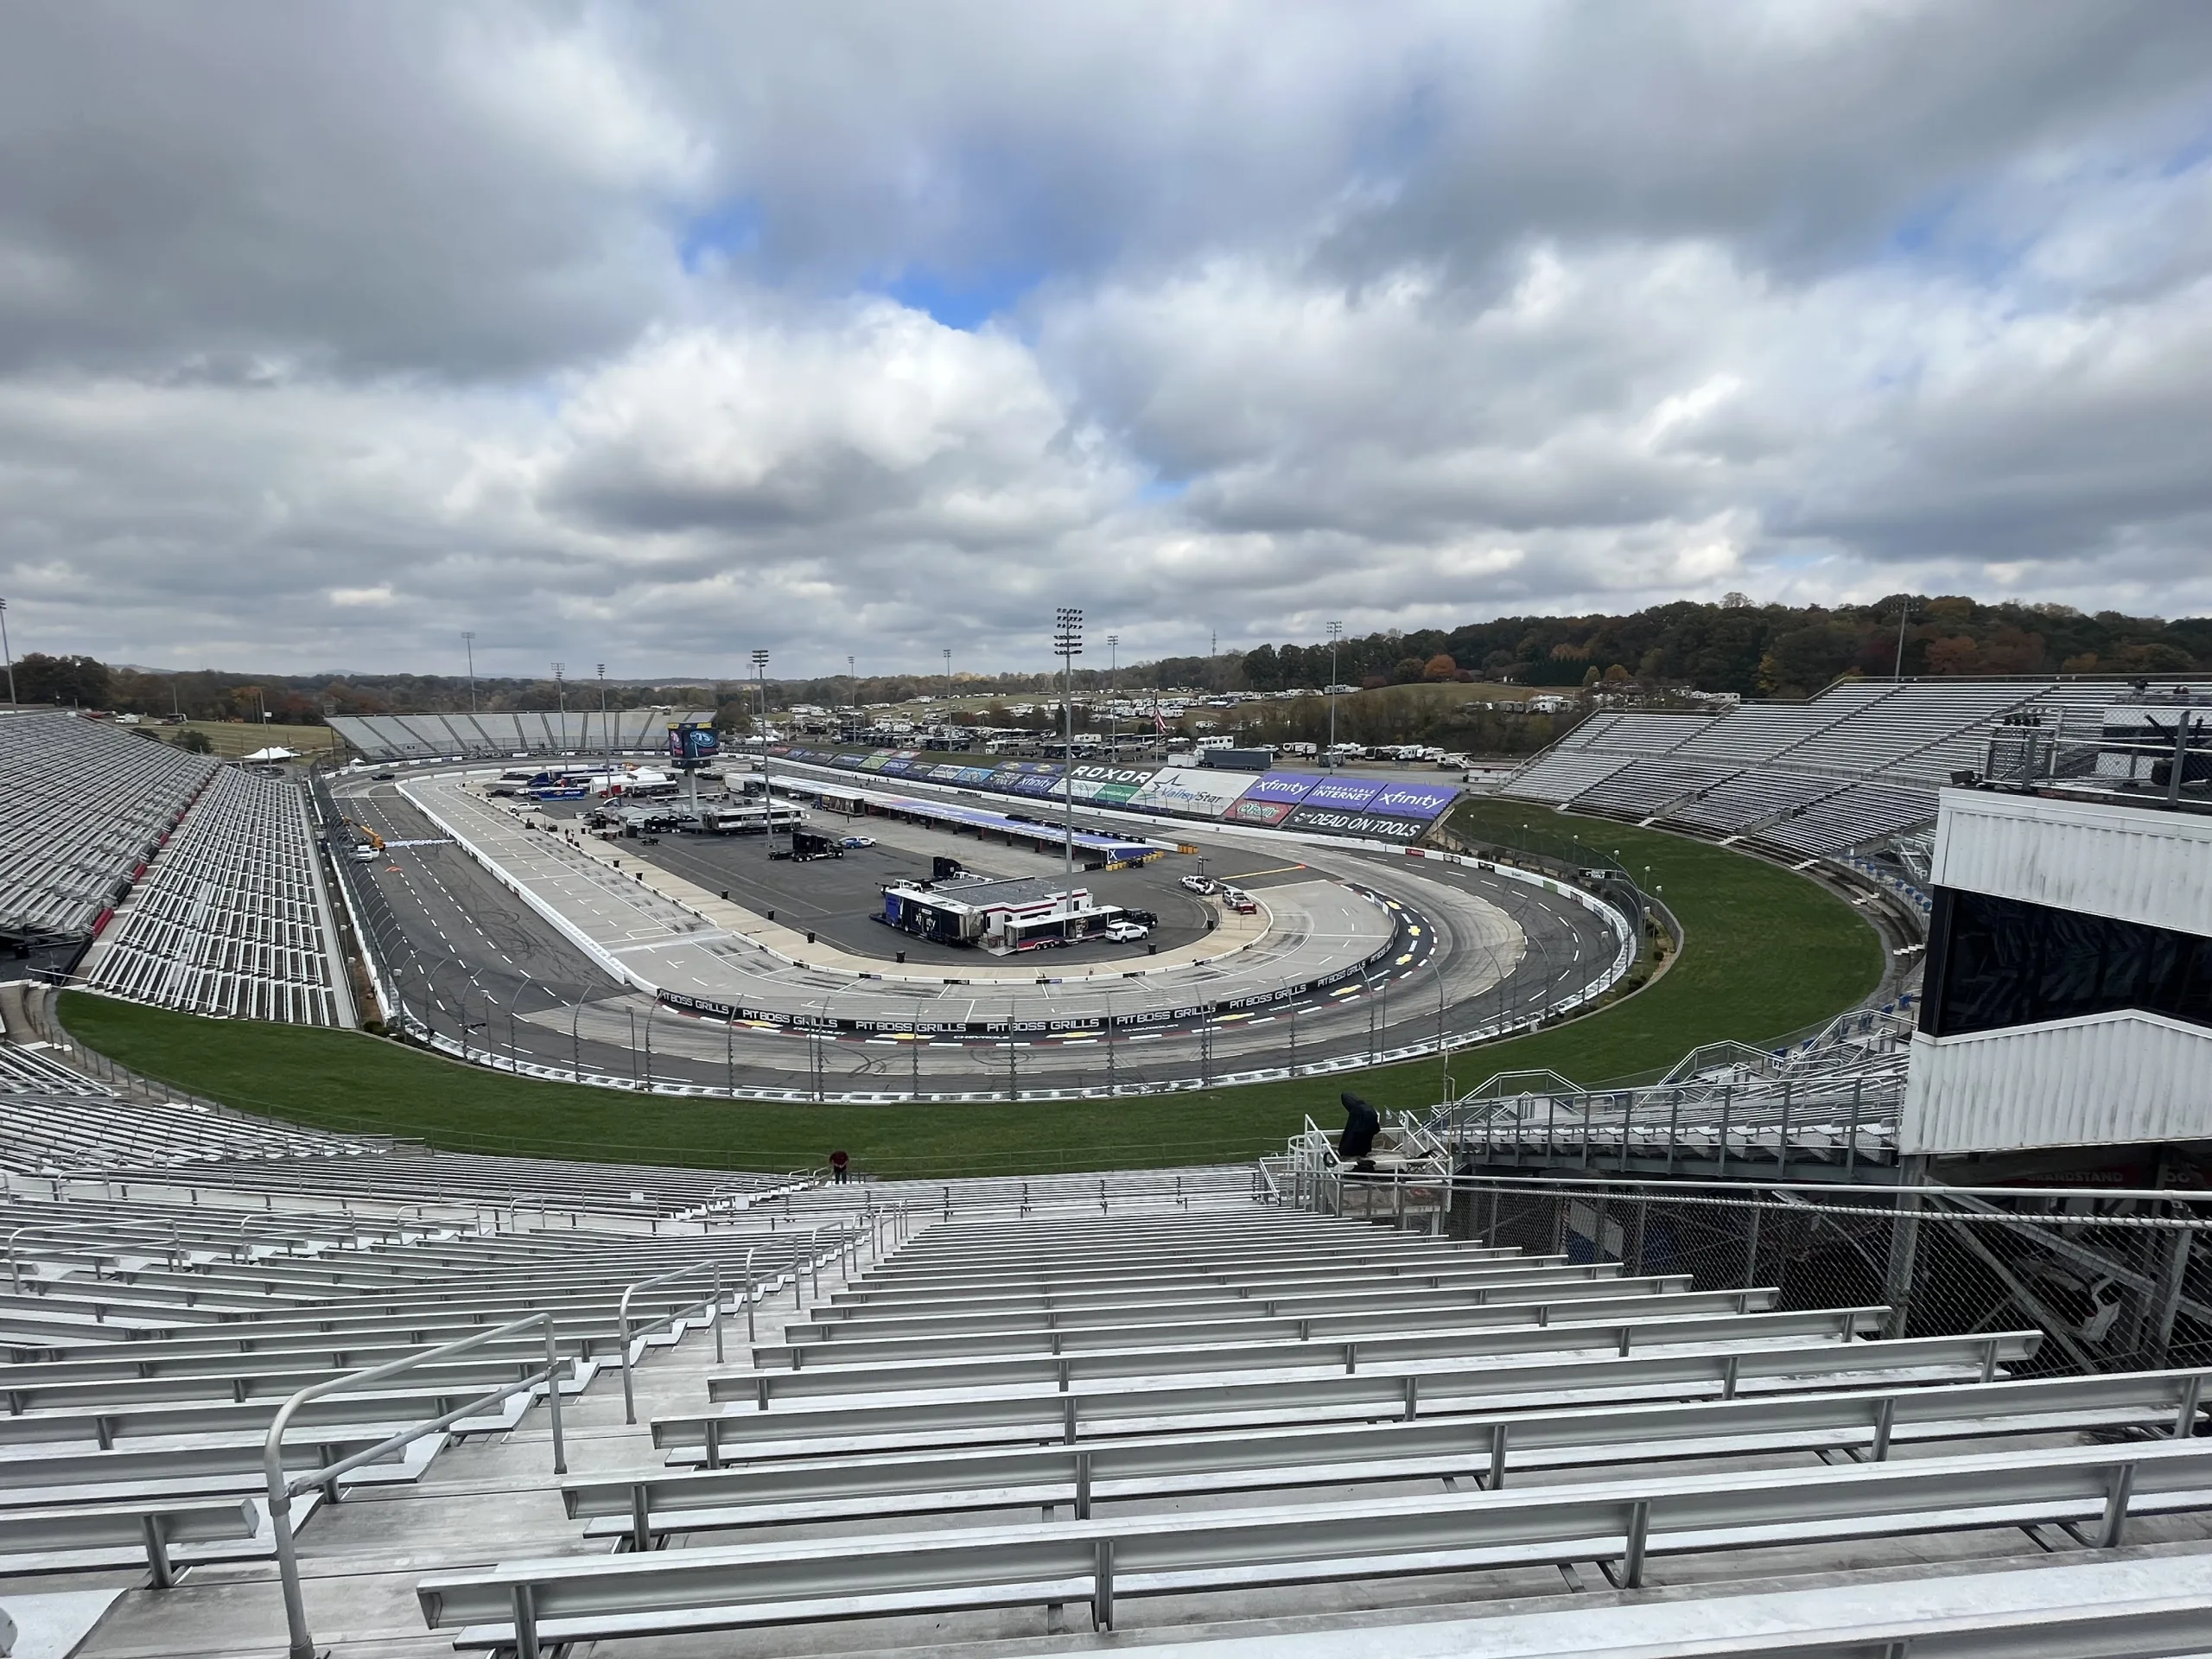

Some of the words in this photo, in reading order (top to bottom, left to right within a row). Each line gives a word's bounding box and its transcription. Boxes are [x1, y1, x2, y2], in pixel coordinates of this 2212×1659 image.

[1018, 776, 1054, 789] xfinity
[1071, 766, 1153, 784] ROXOR
[1256, 779, 1311, 794] xfinity
[1319, 785, 1377, 793] UNBEATABLE
[1312, 790, 1372, 802] INTERNET
[1379, 791, 1446, 810] xfinity
[1308, 813, 1350, 828] DEAD
[1347, 817, 1376, 830] ON
[1370, 820, 1421, 837] TOOLS
[1317, 977, 1328, 988] PIT
[1328, 972, 1347, 984] BOSS
[1346, 961, 1366, 976] GRILLS
[1230, 1000, 1245, 1009] PIT
[1245, 995, 1273, 1005] BOSS
[1274, 984, 1306, 1000] GRLLS
[671, 995, 693, 1007] BOSS
[695, 1000, 729, 1015] GRILLS
[742, 1009, 759, 1020] PIT
[760, 1011, 791, 1023] BOSS
[1116, 1014, 1136, 1026] PIT
[1136, 1011, 1171, 1022] BOSS
[855, 1020, 875, 1031] PIT
[876, 1021, 913, 1032] BOSS
[916, 1023, 967, 1033] GRILLS
[987, 1023, 1007, 1032] PIT
[1050, 1019, 1100, 1030] GRILLS
